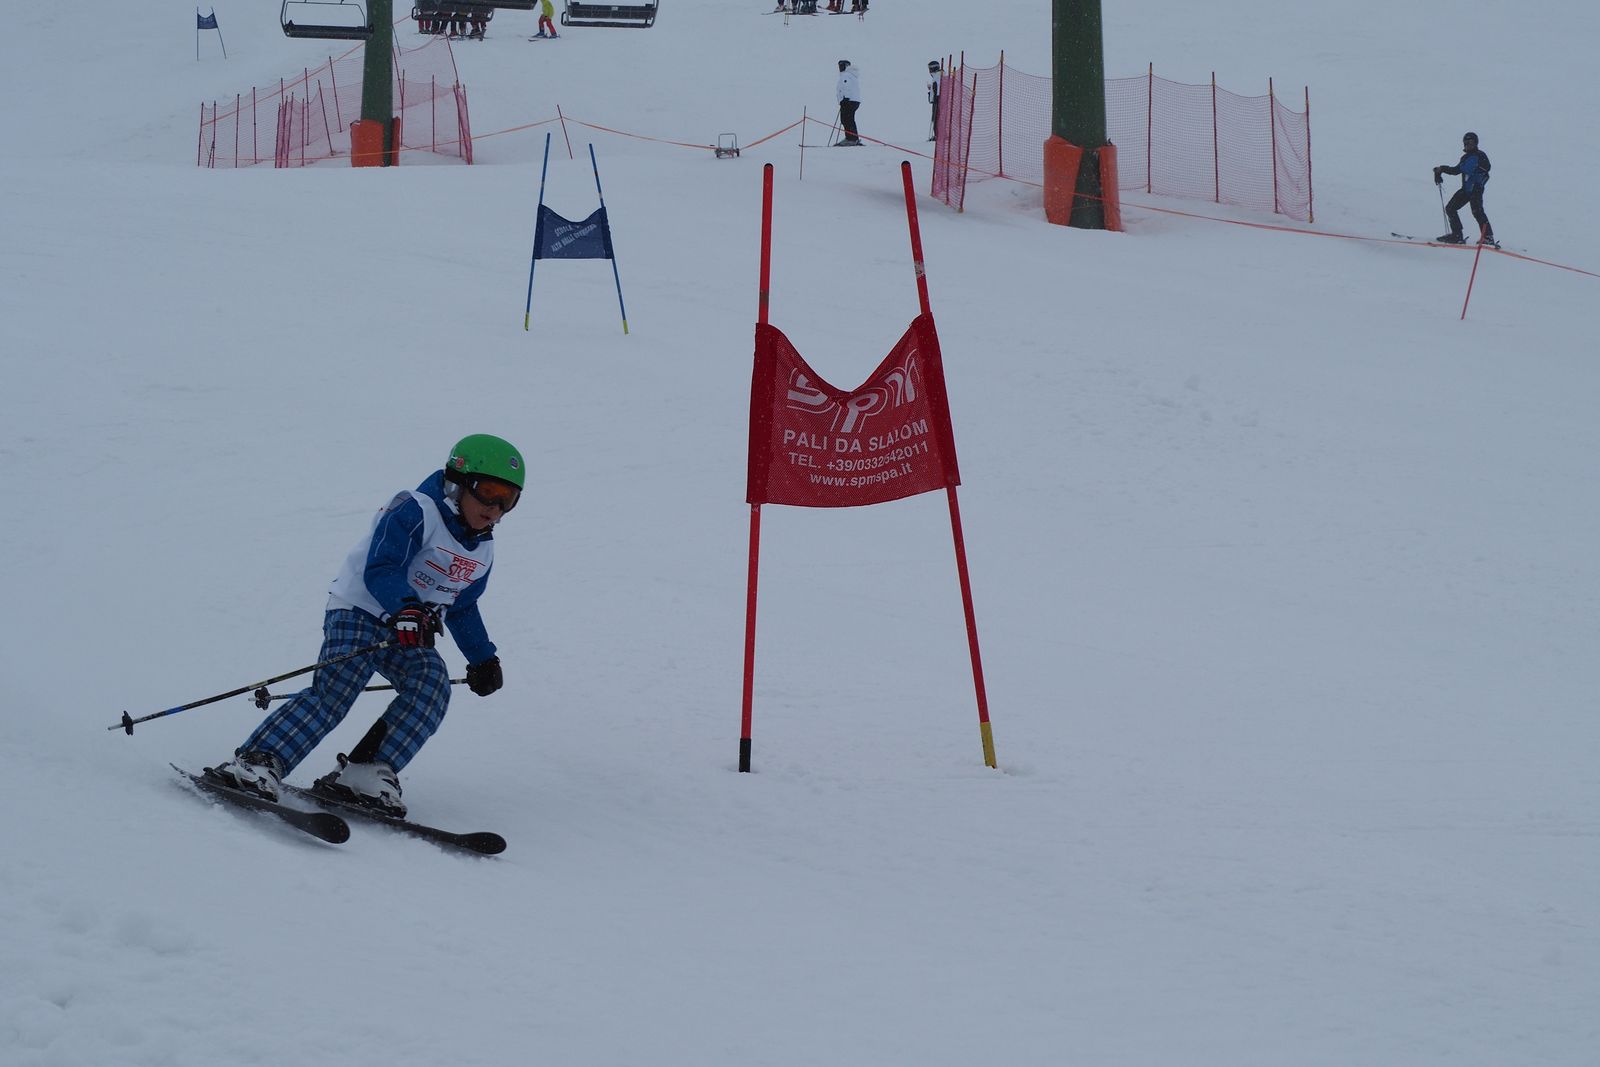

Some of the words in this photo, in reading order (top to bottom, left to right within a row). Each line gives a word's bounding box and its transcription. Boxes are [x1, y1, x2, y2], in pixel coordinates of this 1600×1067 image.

[783, 429, 827, 450] PALI
[835, 438, 862, 453] DA
[868, 419, 929, 451] SLALOM
[788, 452, 821, 469] TEL.
[809, 463, 913, 488] www.spmspa.it
